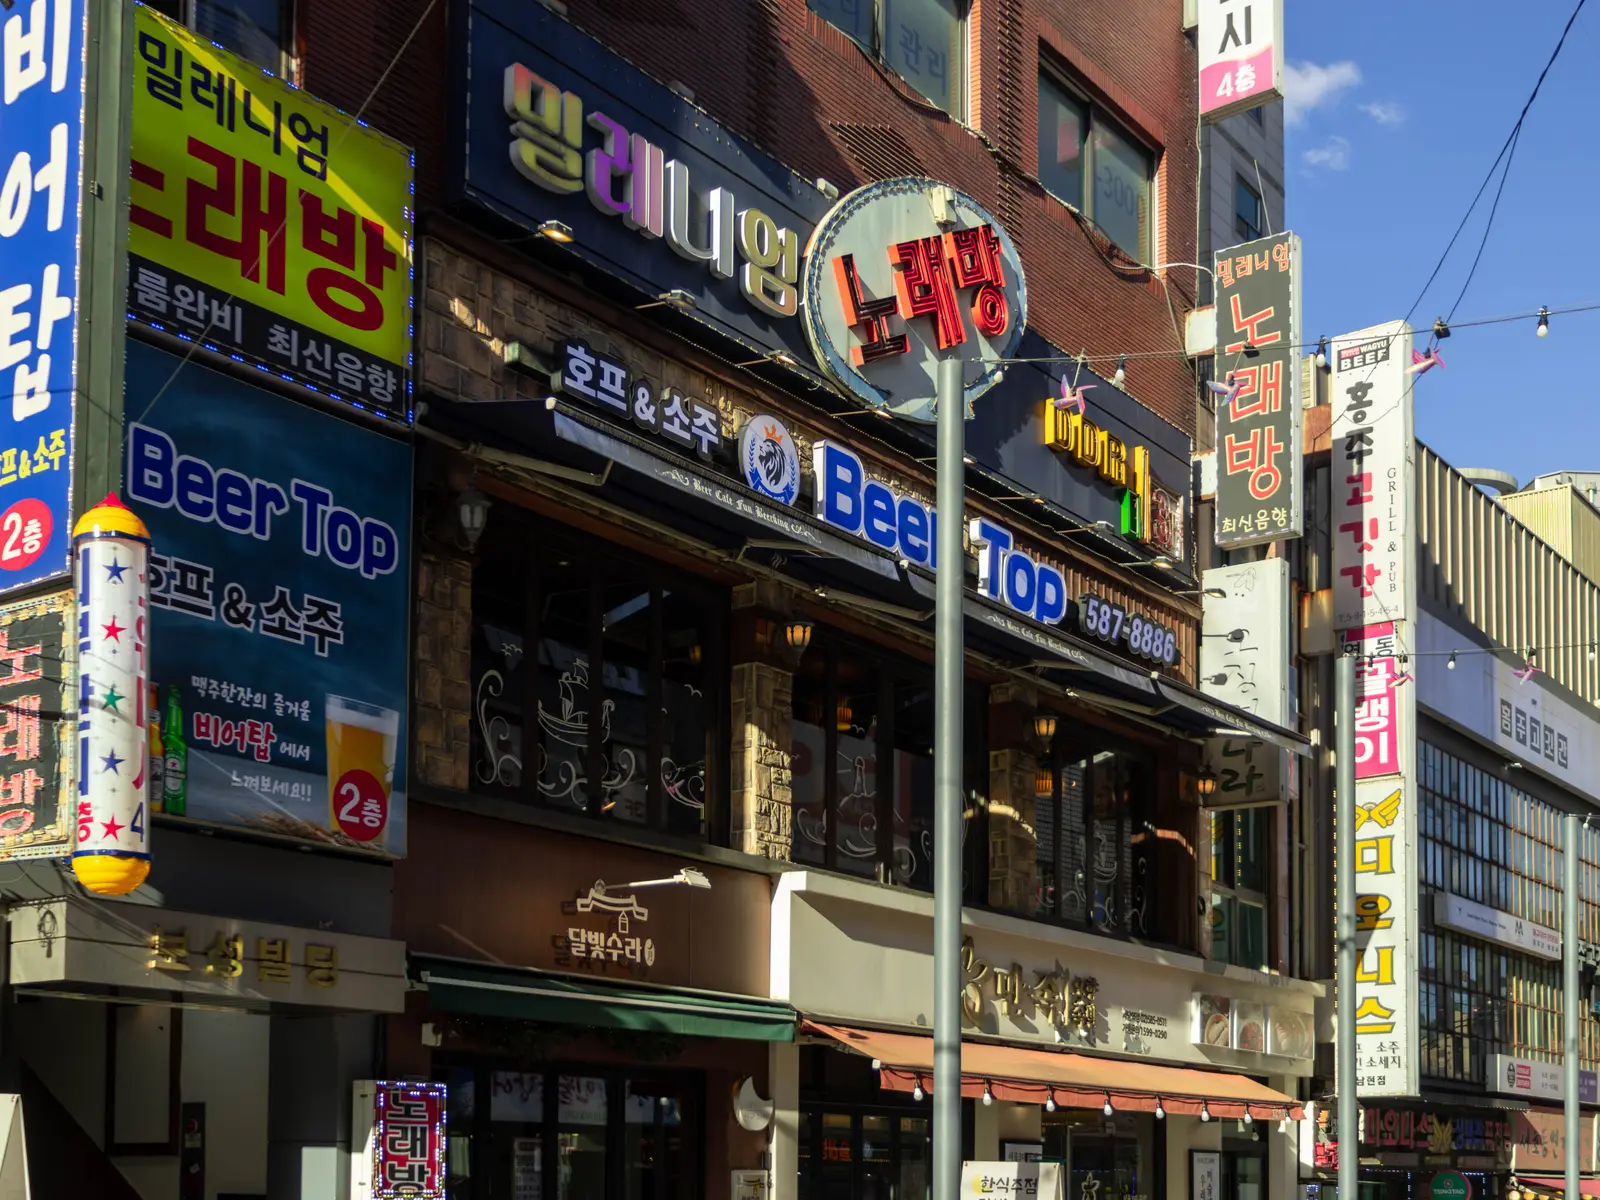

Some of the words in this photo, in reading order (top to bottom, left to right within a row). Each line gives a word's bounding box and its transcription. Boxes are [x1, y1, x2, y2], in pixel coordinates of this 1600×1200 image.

[1216, 65, 1257, 98] 4층
[139, 30, 328, 181] 밀레니엄
[504, 62, 798, 318] 밀레니엄
[1217, 243, 1289, 287] 밀레니엄
[832, 223, 1009, 366] 노래방
[133, 267, 243, 343] 룸완비
[266, 323, 397, 402] 최신음향
[1360, 340, 1387, 353] WAGYU
[1341, 349, 1386, 370] BEEF
[1224, 294, 1284, 500] 노래방
[127, 420, 290, 541] Beer
[291, 477, 399, 580] Top
[693, 477, 712, 496] Beer
[1387, 467, 1397, 532] GRILL
[3, 510, 42, 556] 2층
[826, 443, 936, 572] Bee
[974, 518, 1067, 624] Top
[1221, 505, 1288, 534] 최신음향
[1389, 561, 1397, 593] PUB
[1085, 598, 1175, 663] 587-8886
[191, 674, 266, 710] 맥주한잔의
[272, 692, 311, 722] 즐거움
[193, 711, 276, 762] 비어탑
[279, 741, 310, 762] 에서
[339, 783, 381, 828] 2층
[567, 928, 642, 963] 달빛수라
[1376, 1041, 1400, 1054] 소주
[386, 1088, 430, 1195] 노래방
[1366, 1108, 1433, 1149] 디오니스
[981, 1176, 1037, 1194] 한식주점
